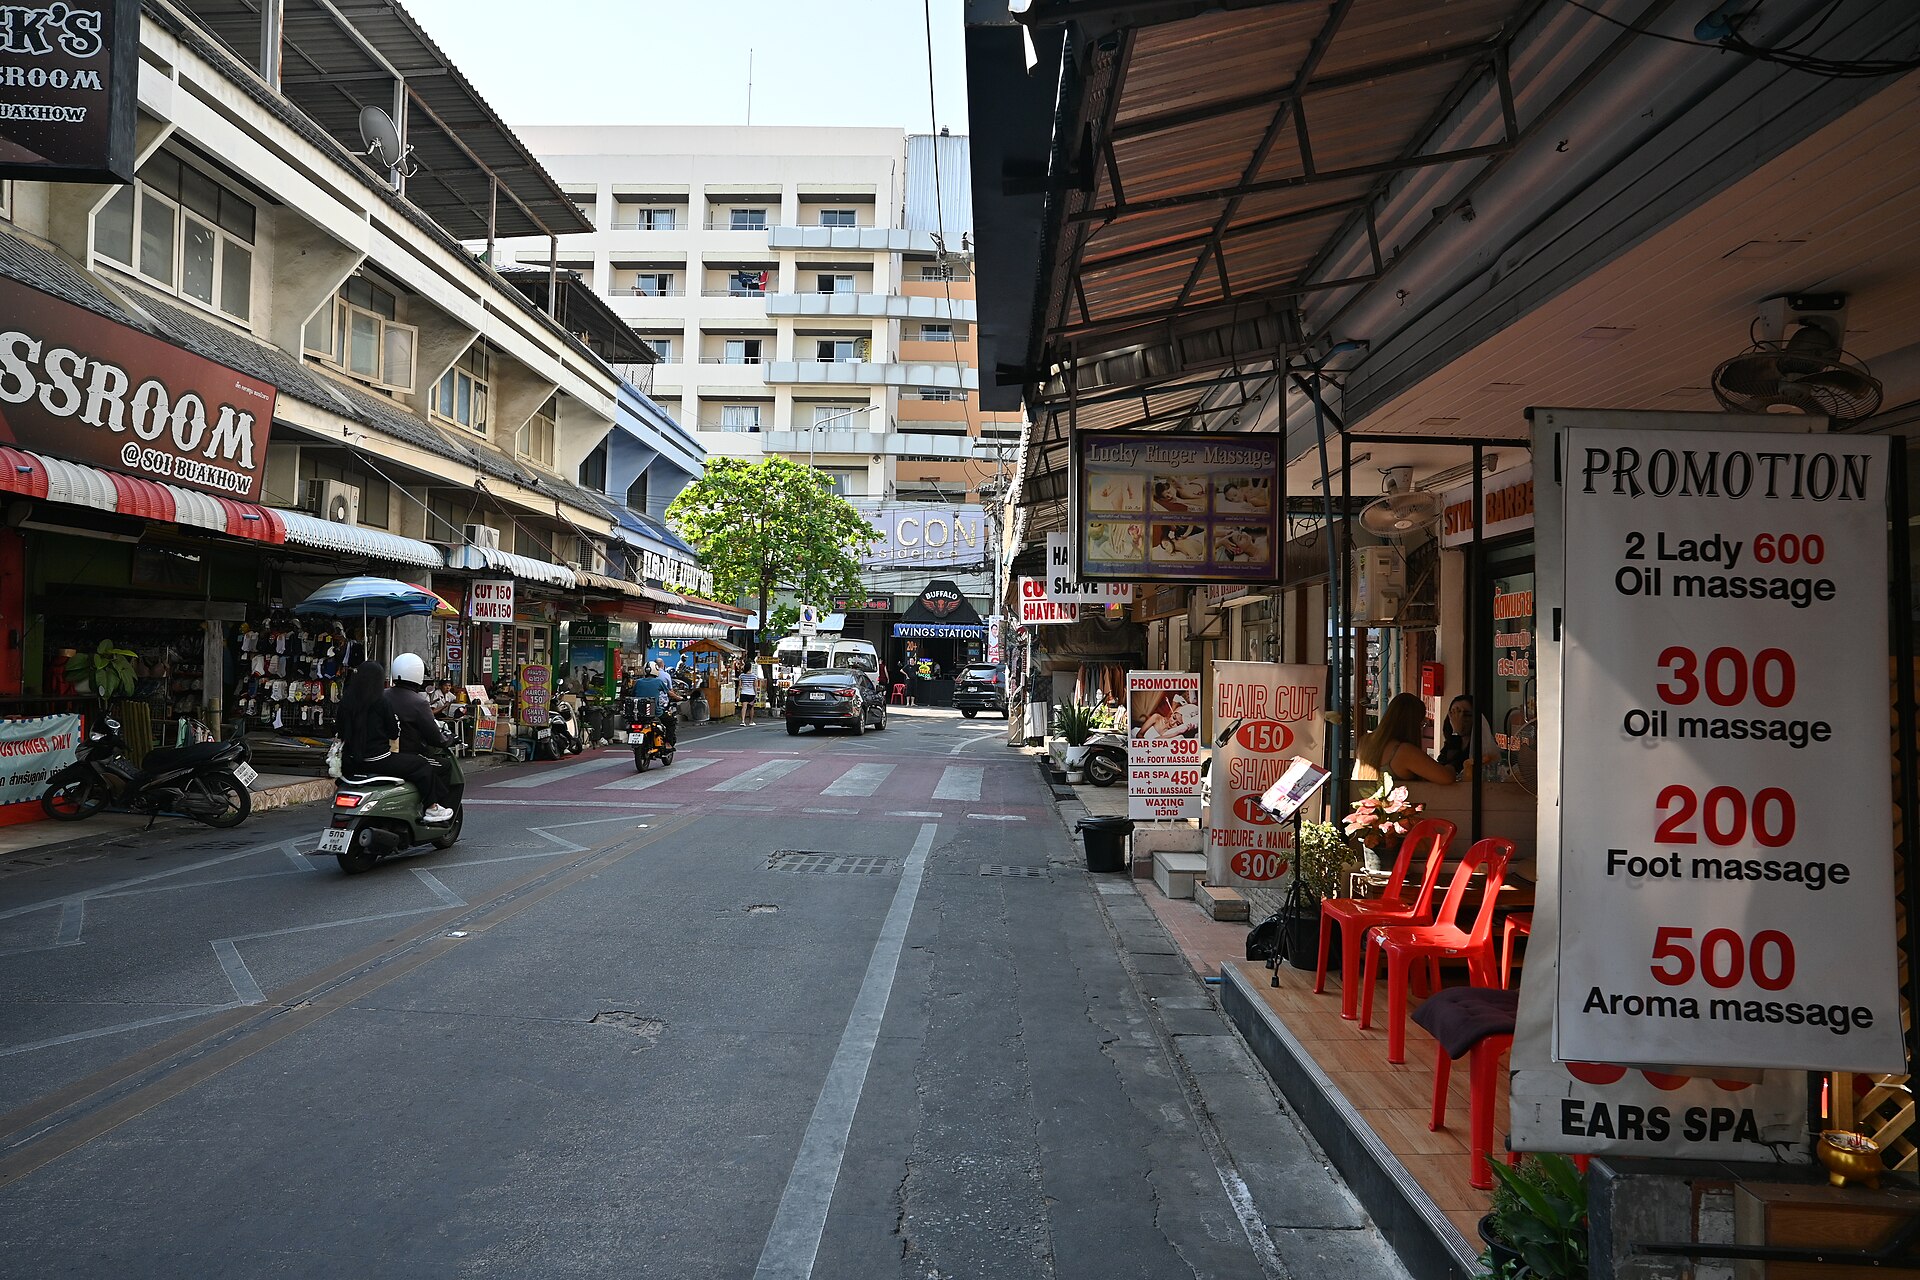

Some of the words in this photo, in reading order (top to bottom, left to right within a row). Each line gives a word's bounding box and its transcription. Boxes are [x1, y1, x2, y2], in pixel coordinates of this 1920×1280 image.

[0, 3, 102, 57] K’S
[0, 331, 255, 470] SSROOM
[1090, 443, 1139, 467] Lucky
[1145, 444, 1197, 468] Finger
[1203, 446, 1272, 470] Massage
[174, 457, 252, 494] BUAKHOW
[1583, 446, 1872, 501] PROMOTION
[1625, 531, 1645, 560] 2
[1657, 531, 1743, 569] Lady
[1753, 532, 1826, 565] 600
[474, 585, 493, 599] CUT
[496, 586, 512, 601] 150
[925, 590, 958, 600] BUFFALO
[1023, 580, 1047, 598] CU
[1054, 576, 1098, 594] SHAVE
[1614, 566, 1661, 597] Oil
[1673, 574, 1836, 609] massage
[475, 602, 497, 618] SHAVE
[498, 604, 512, 619] 150
[1024, 603, 1055, 620] SHAVE
[576, 626, 596, 635] ATM
[899, 627, 935, 637] WINGS
[938, 628, 980, 638] STATION
[1131, 679, 1198, 690] PROMOTION
[1656, 646, 1796, 708] 300
[530, 696, 543, 704] 150
[1218, 684, 1268, 720] HAIR
[1275, 686, 1318, 721] CUT
[529, 716, 542, 724] 150
[1623, 709, 1667, 738] Oil
[1678, 714, 1832, 749] massage
[1247, 725, 1284, 745] 150
[0, 737, 50, 757] USTOMER
[1132, 740, 1149, 748] EAR
[1152, 740, 1168, 748] SPA
[1170, 739, 1198, 755] 390
[1132, 771, 1150, 779] EAR
[1153, 771, 1169, 779] SPA
[1171, 771, 1198, 785] 450
[1229, 757, 1294, 791] SHAV
[1145, 798, 1184, 807] WAXING
[1654, 785, 1796, 847] 200
[322, 844, 343, 852] 4154
[1211, 829, 1254, 847] PEDICURE
[1257, 833, 1263, 847] &
[1241, 854, 1278, 876] 300
[1607, 850, 1681, 878] Foot
[1692, 858, 1850, 890] massage
[1651, 927, 1796, 991] 500
[1583, 987, 1700, 1019] Aroma
[1710, 1000, 1873, 1035] massage
[1561, 1099, 1670, 1142] EARS
[1683, 1107, 1759, 1143] SPA
